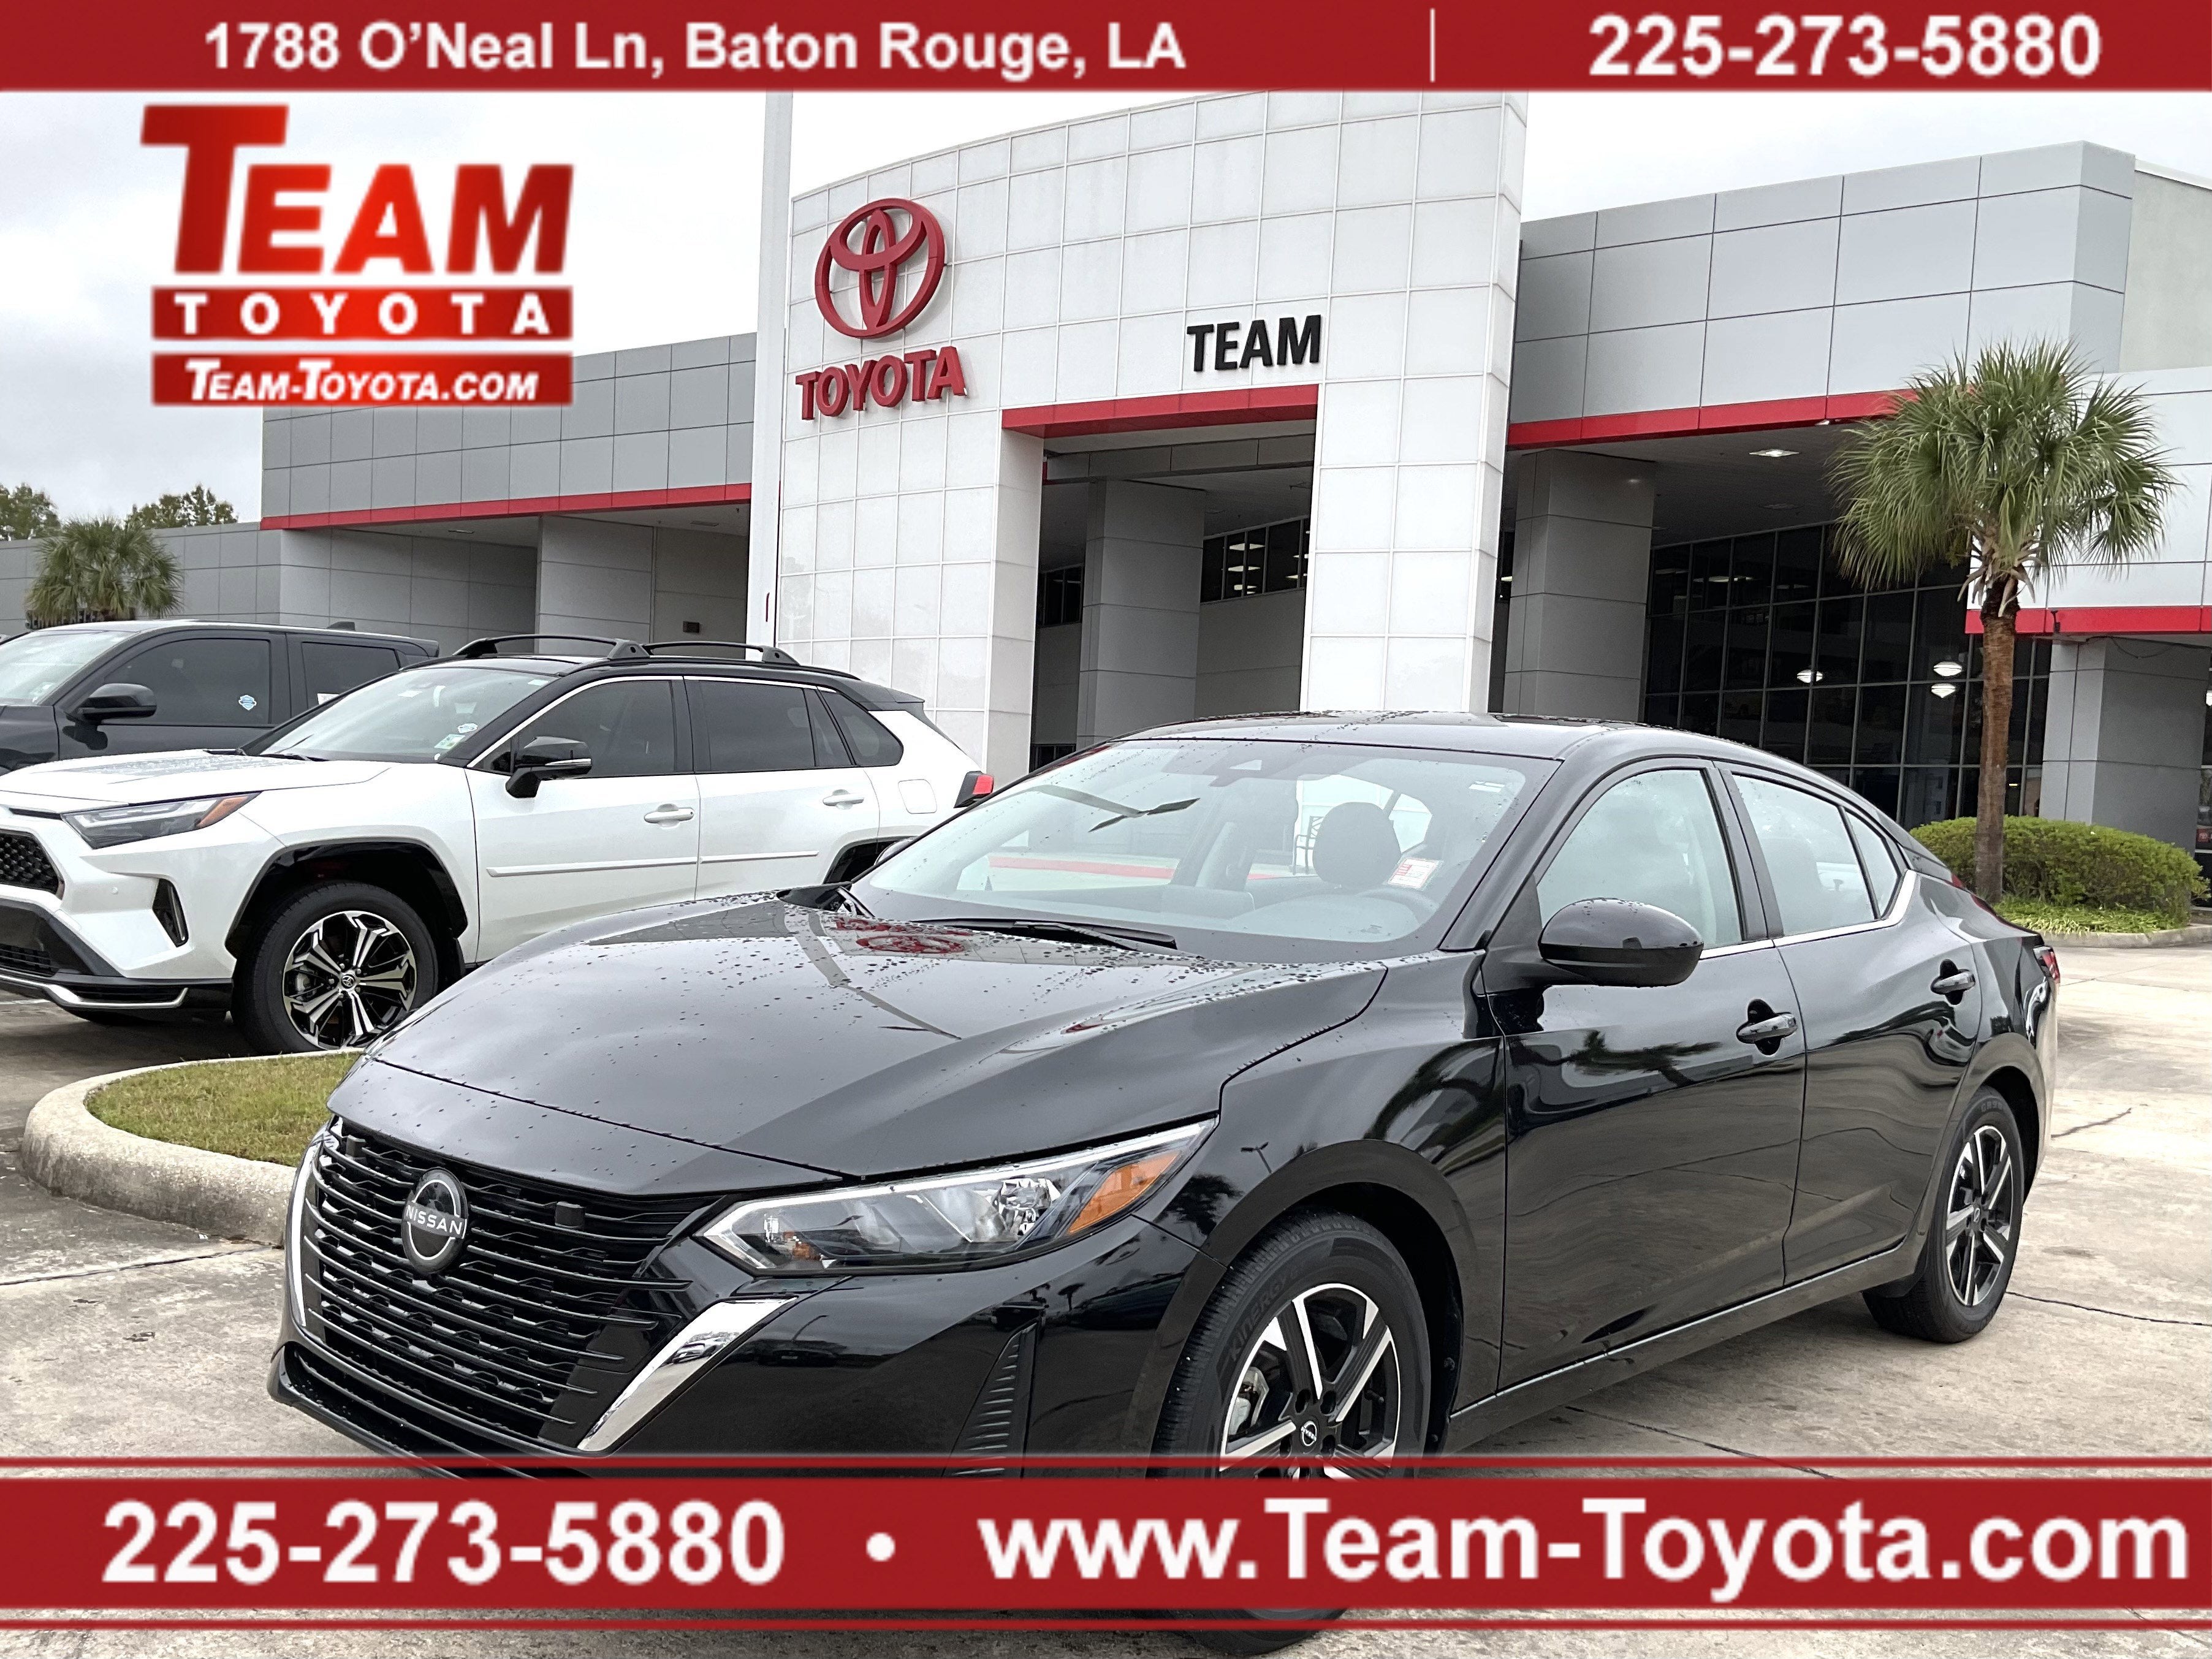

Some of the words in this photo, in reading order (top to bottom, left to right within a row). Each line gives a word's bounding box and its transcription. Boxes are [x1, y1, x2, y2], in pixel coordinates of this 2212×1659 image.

[1187, 315, 1321, 372] TEAM
[796, 346, 966, 420] TOYOTA
[406, 1204, 463, 1235] NISSAN
